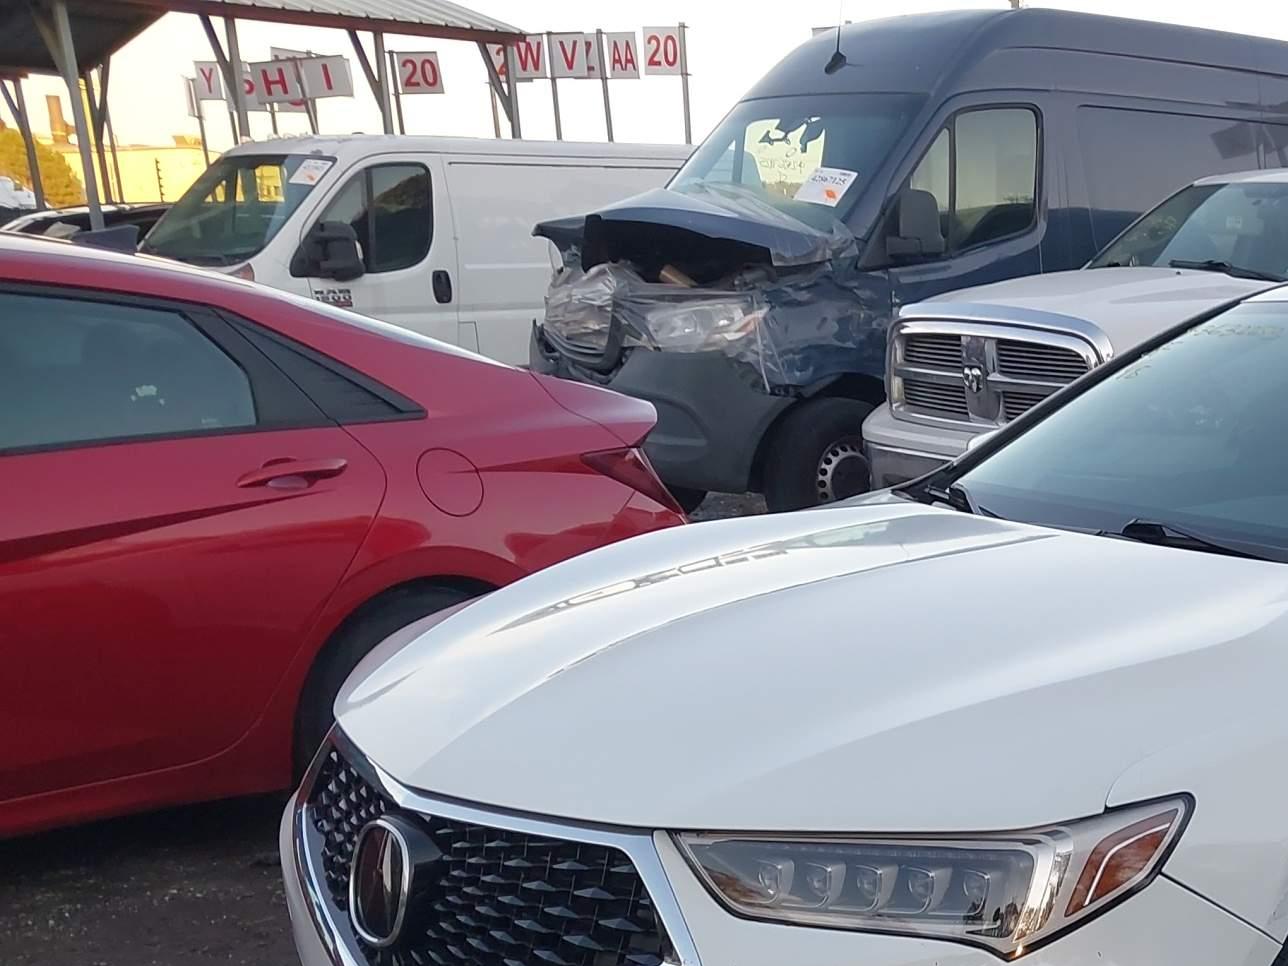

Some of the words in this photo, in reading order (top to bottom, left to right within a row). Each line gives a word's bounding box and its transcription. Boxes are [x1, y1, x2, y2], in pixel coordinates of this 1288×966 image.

[516, 41, 542, 72] W
[559, 40, 578, 71] V
[612, 39, 637, 72] AA
[647, 34, 678, 67] 20
[200, 67, 213, 94] Y
[261, 67, 289, 97] H
[321, 63, 333, 91] I
[401, 58, 438, 88] 20
